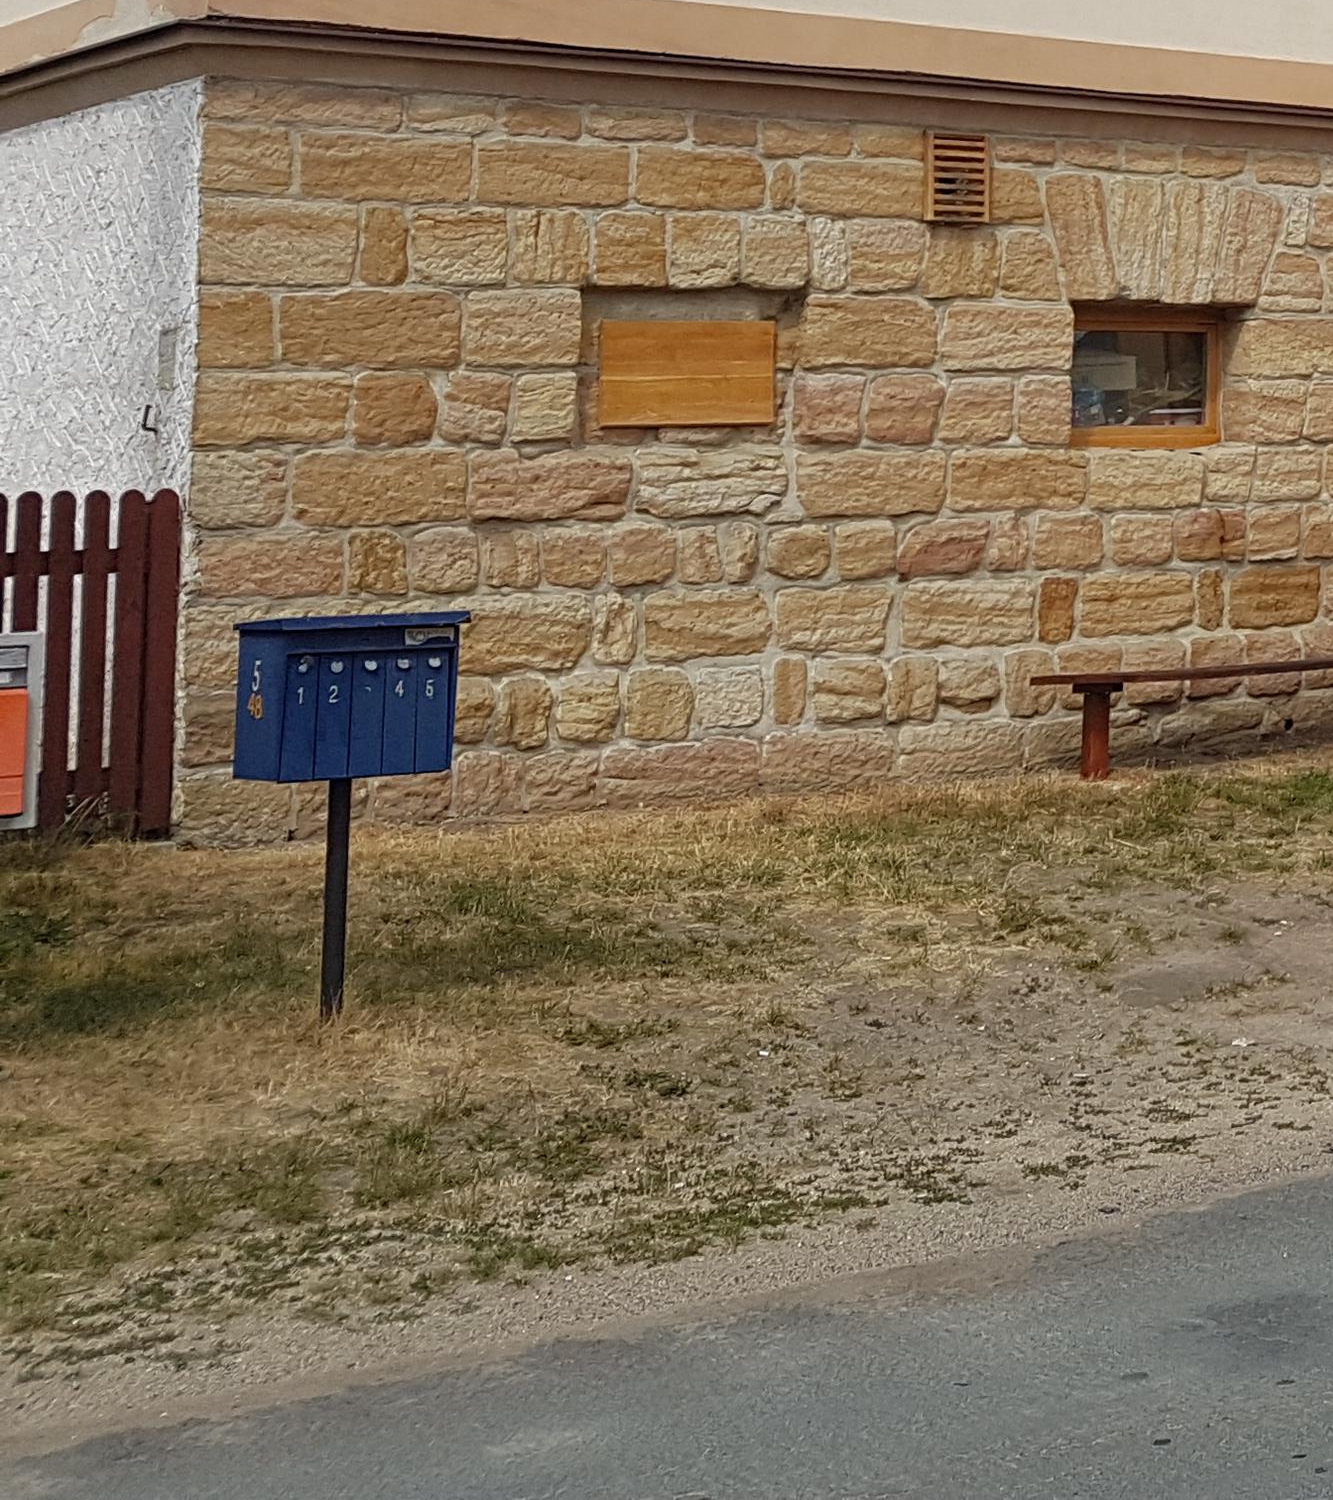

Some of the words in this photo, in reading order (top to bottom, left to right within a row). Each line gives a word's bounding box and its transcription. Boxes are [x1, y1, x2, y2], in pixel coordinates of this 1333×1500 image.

[252, 660, 261, 691] 5
[297, 687, 304, 705] 1
[328, 685, 339, 704] 2
[395, 680, 404, 697] 4
